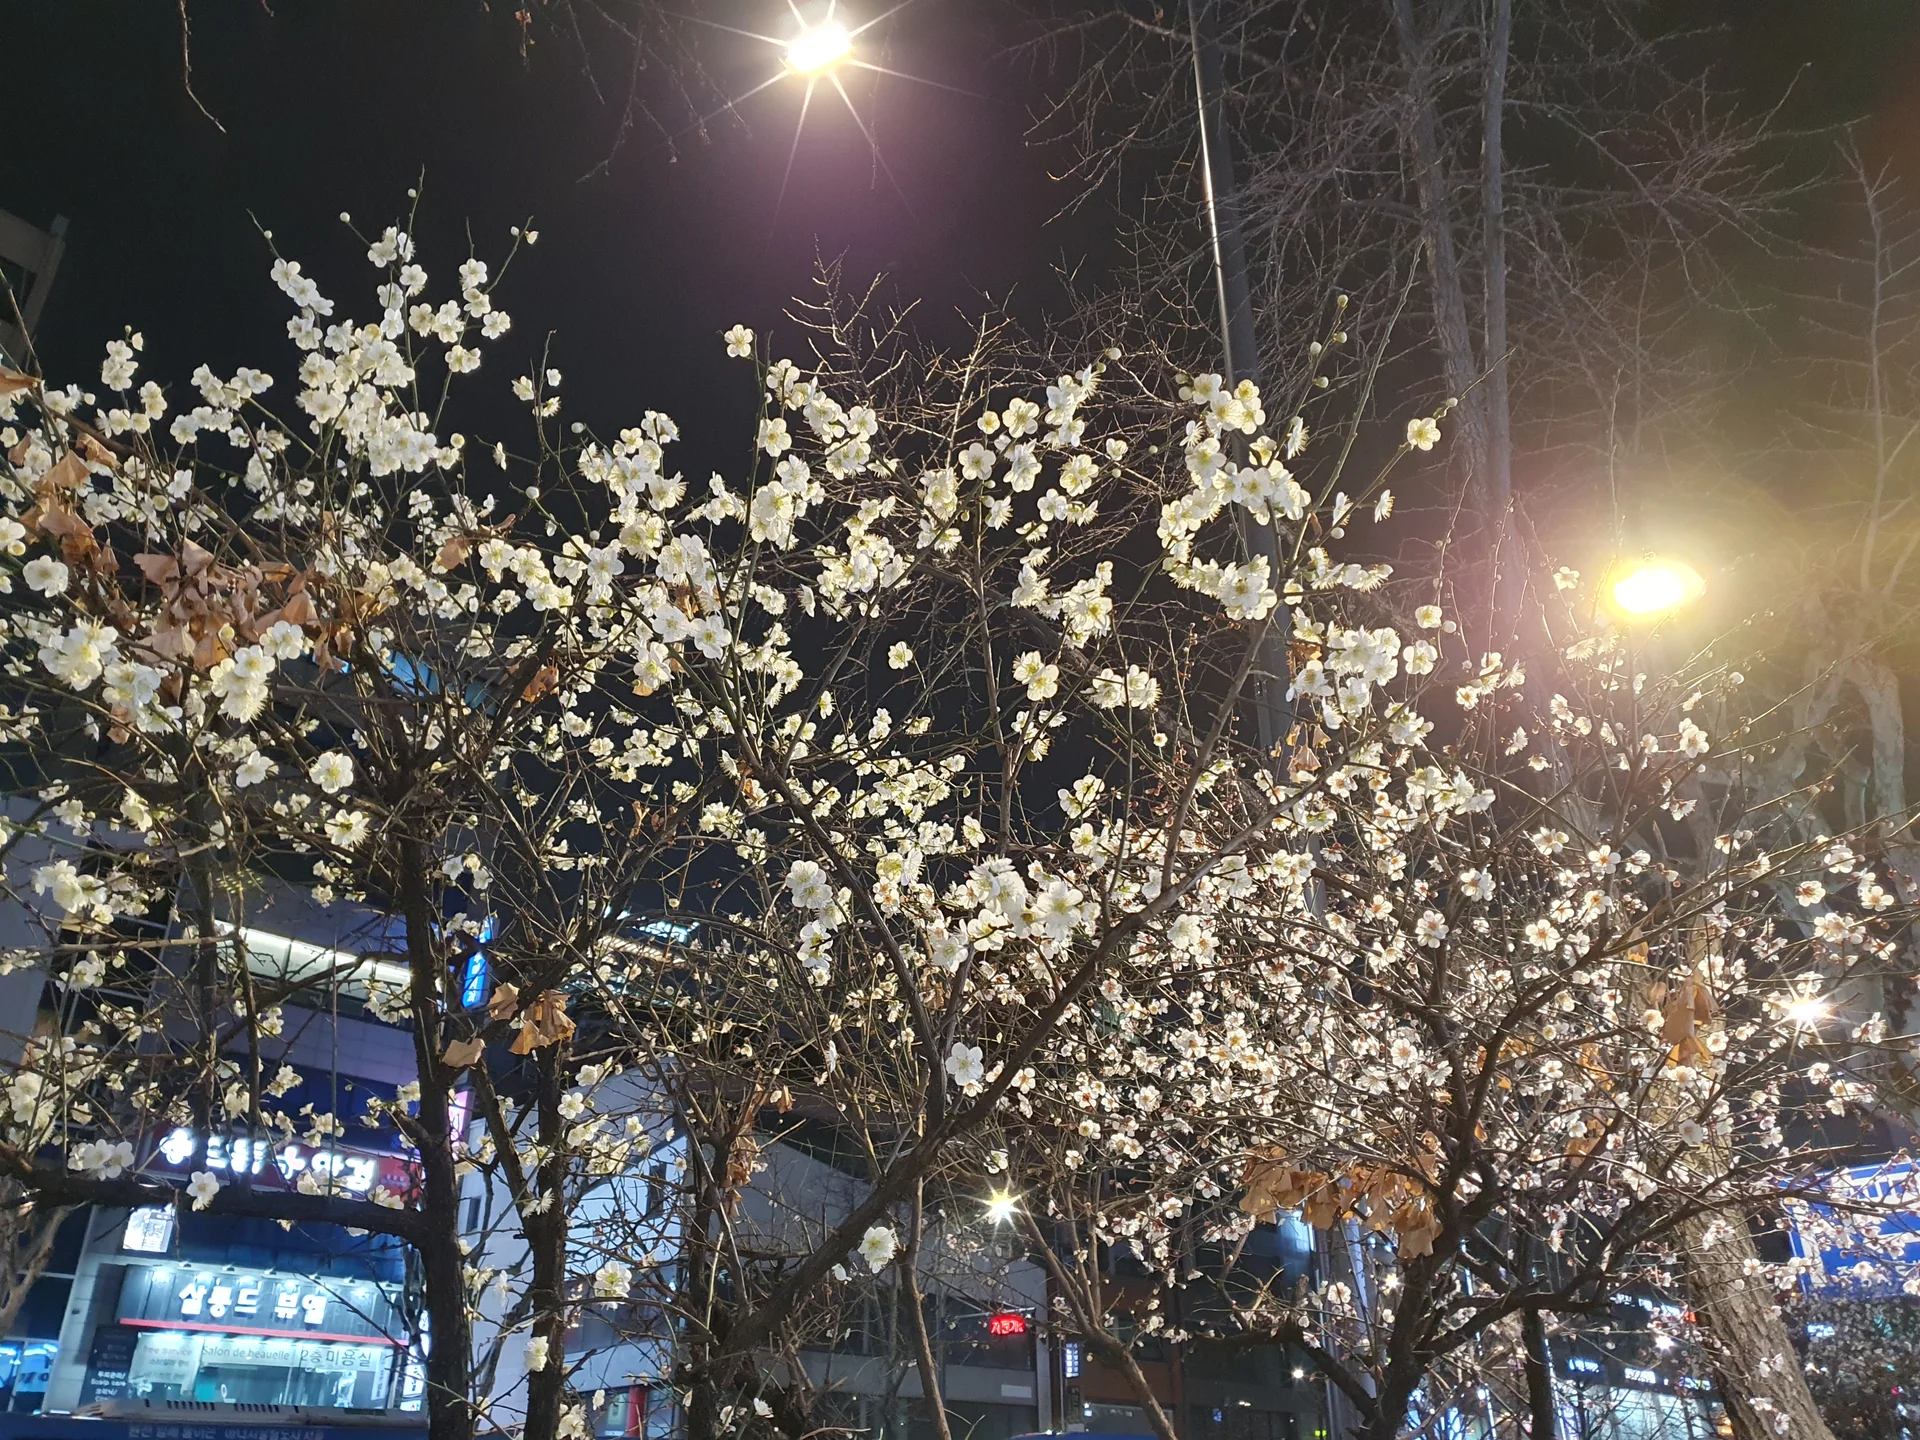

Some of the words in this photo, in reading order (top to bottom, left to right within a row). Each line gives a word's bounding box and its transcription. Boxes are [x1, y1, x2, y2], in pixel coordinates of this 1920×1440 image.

[178, 1283, 259, 1318] 살롱드
[201, 1345, 230, 1357] Salon
[232, 1347, 245, 1358] de
